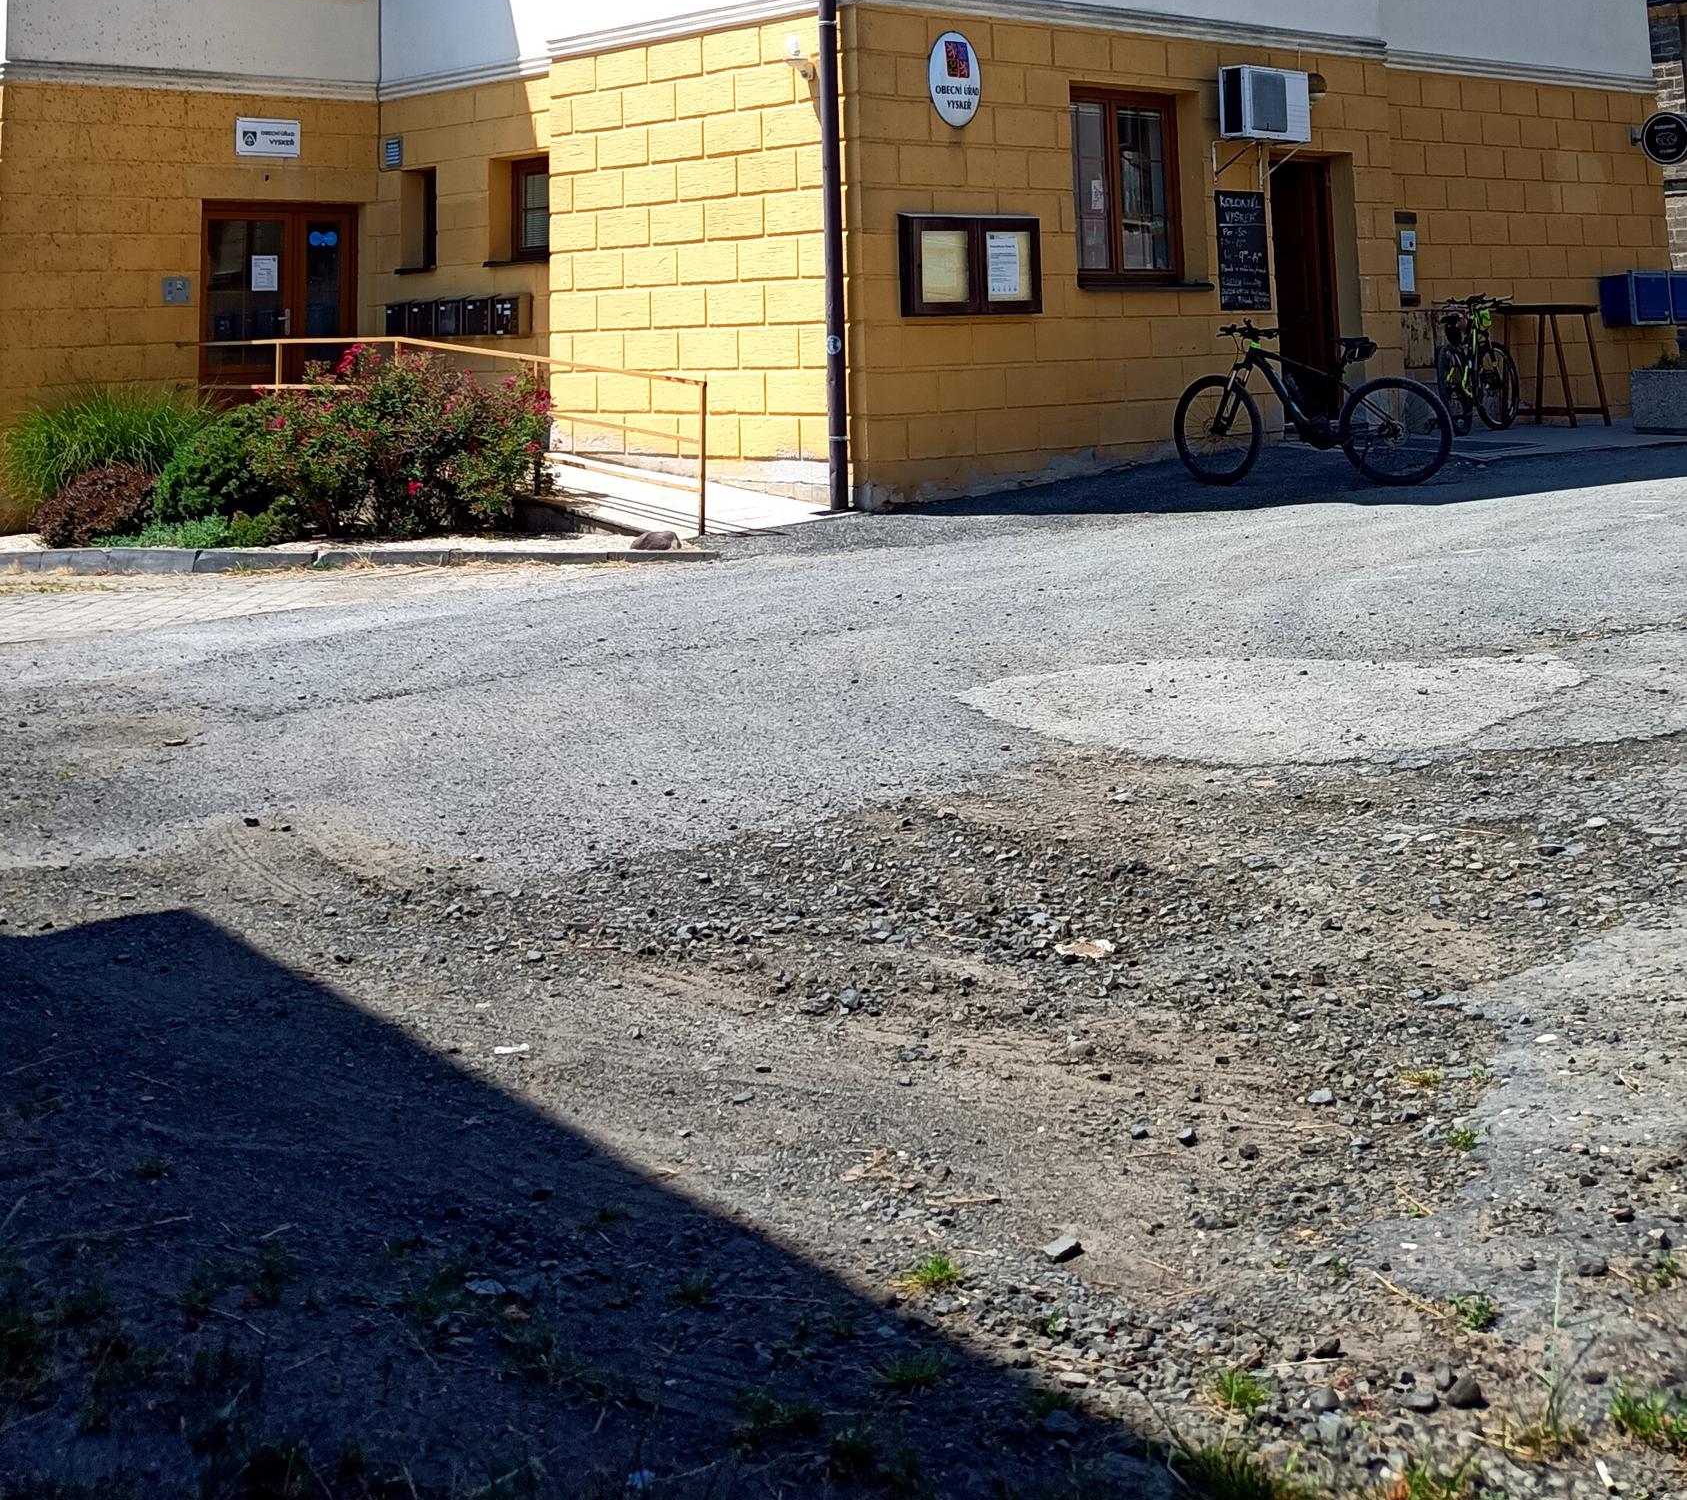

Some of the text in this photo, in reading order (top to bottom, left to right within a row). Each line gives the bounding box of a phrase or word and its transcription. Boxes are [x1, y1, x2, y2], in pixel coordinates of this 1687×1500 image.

[935, 83, 980, 96] OBECNÍ ÚŘAD
[946, 98, 972, 110] VYSKEŘ
[269, 138, 295, 146] VYSKEŘ
